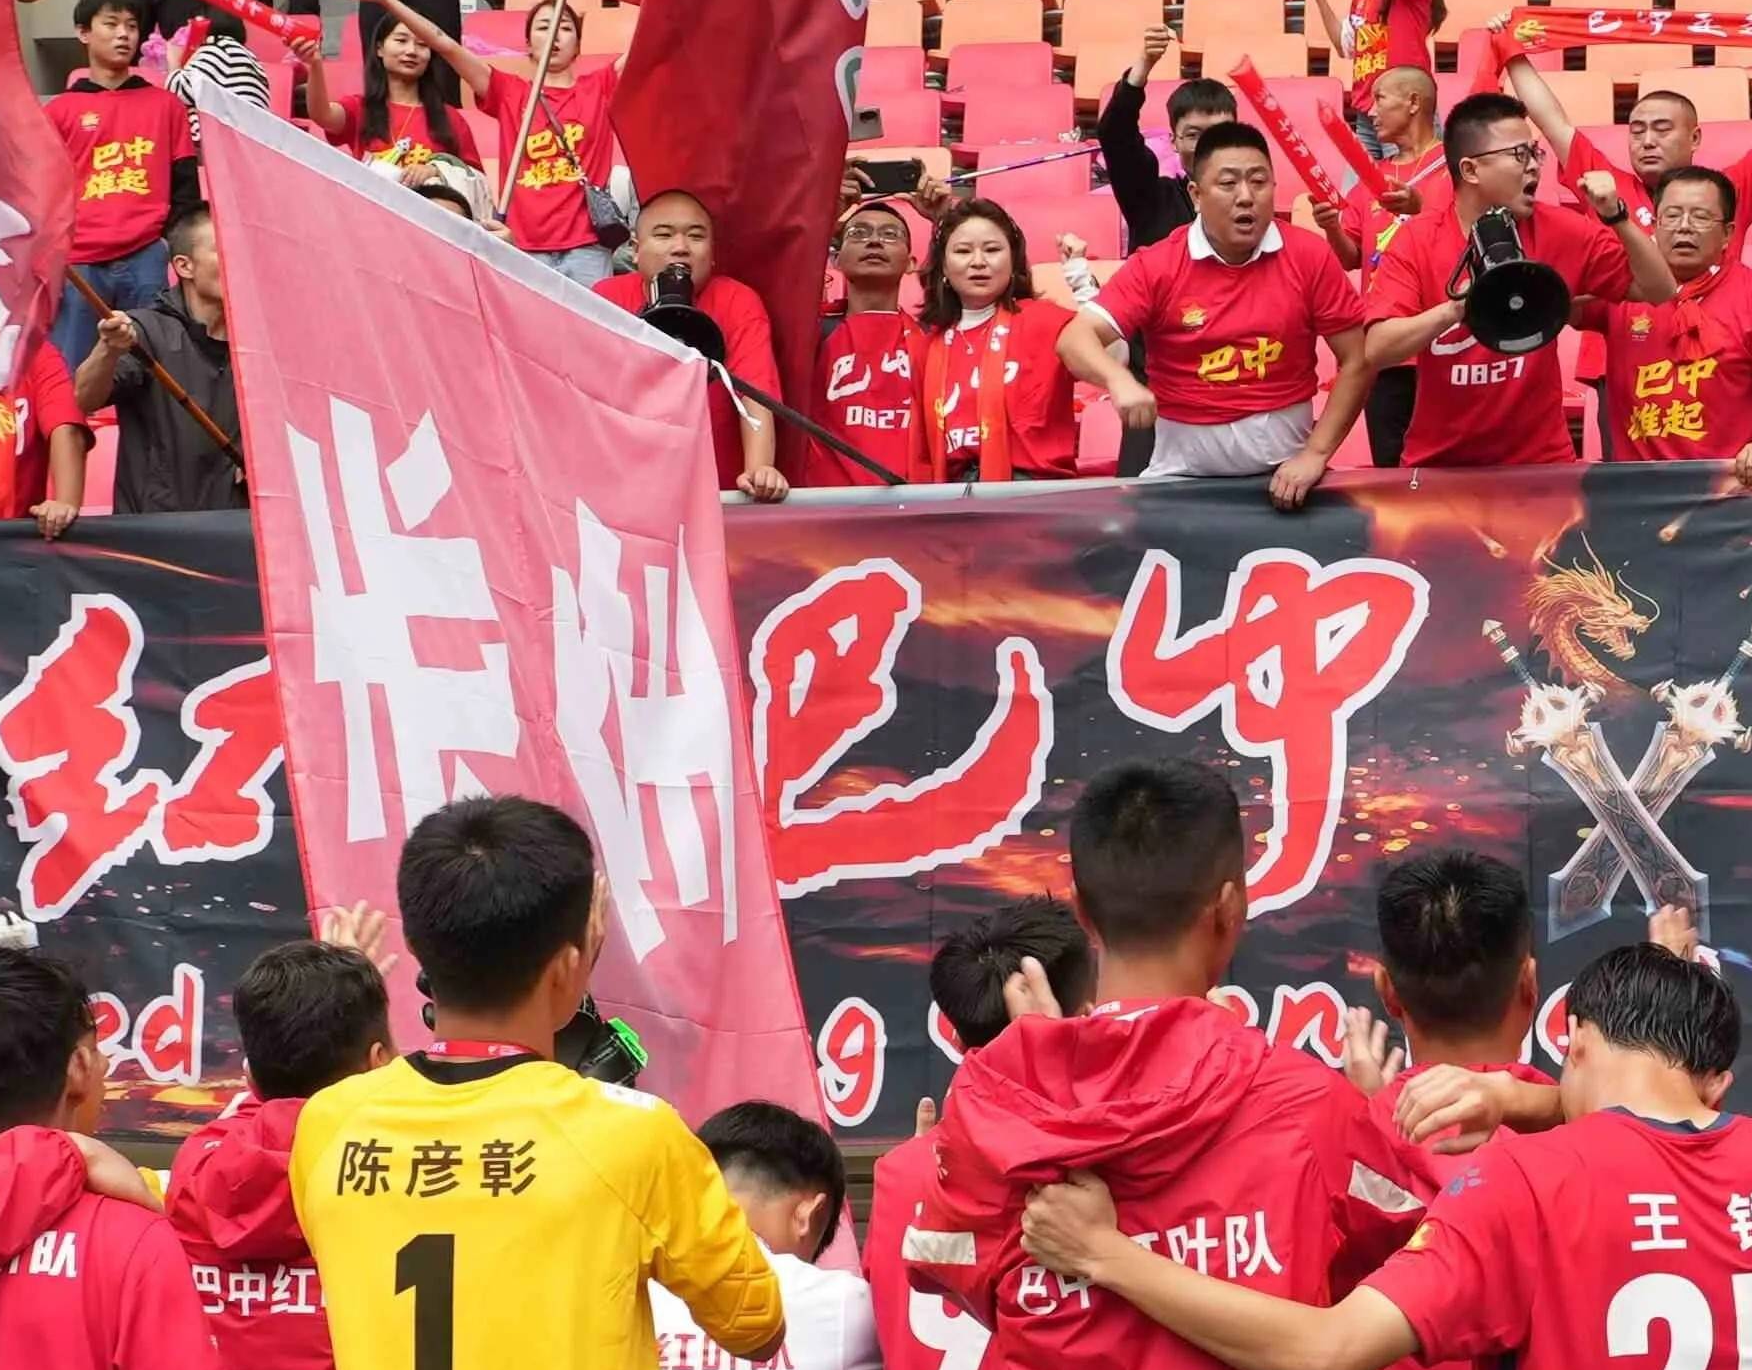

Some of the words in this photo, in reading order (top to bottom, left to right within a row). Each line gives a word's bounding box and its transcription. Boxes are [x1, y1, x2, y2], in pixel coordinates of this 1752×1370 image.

[92, 136, 154, 170] 巴中
[526, 123, 586, 159] 巴中
[80, 167, 152, 201] 雄起
[517, 159, 583, 190] 雄起
[1196, 336, 1284, 383] 巴中
[1450, 356, 1526, 387] 0827
[1636, 358, 1718, 398] 巴中
[845, 405, 911, 429] 0827
[1629, 399, 1708, 442] 雄起
[91, 959, 205, 1087] ed
[336, 1139, 537, 1198] 陈彦彰
[191, 1262, 321, 1316] 巴中红
